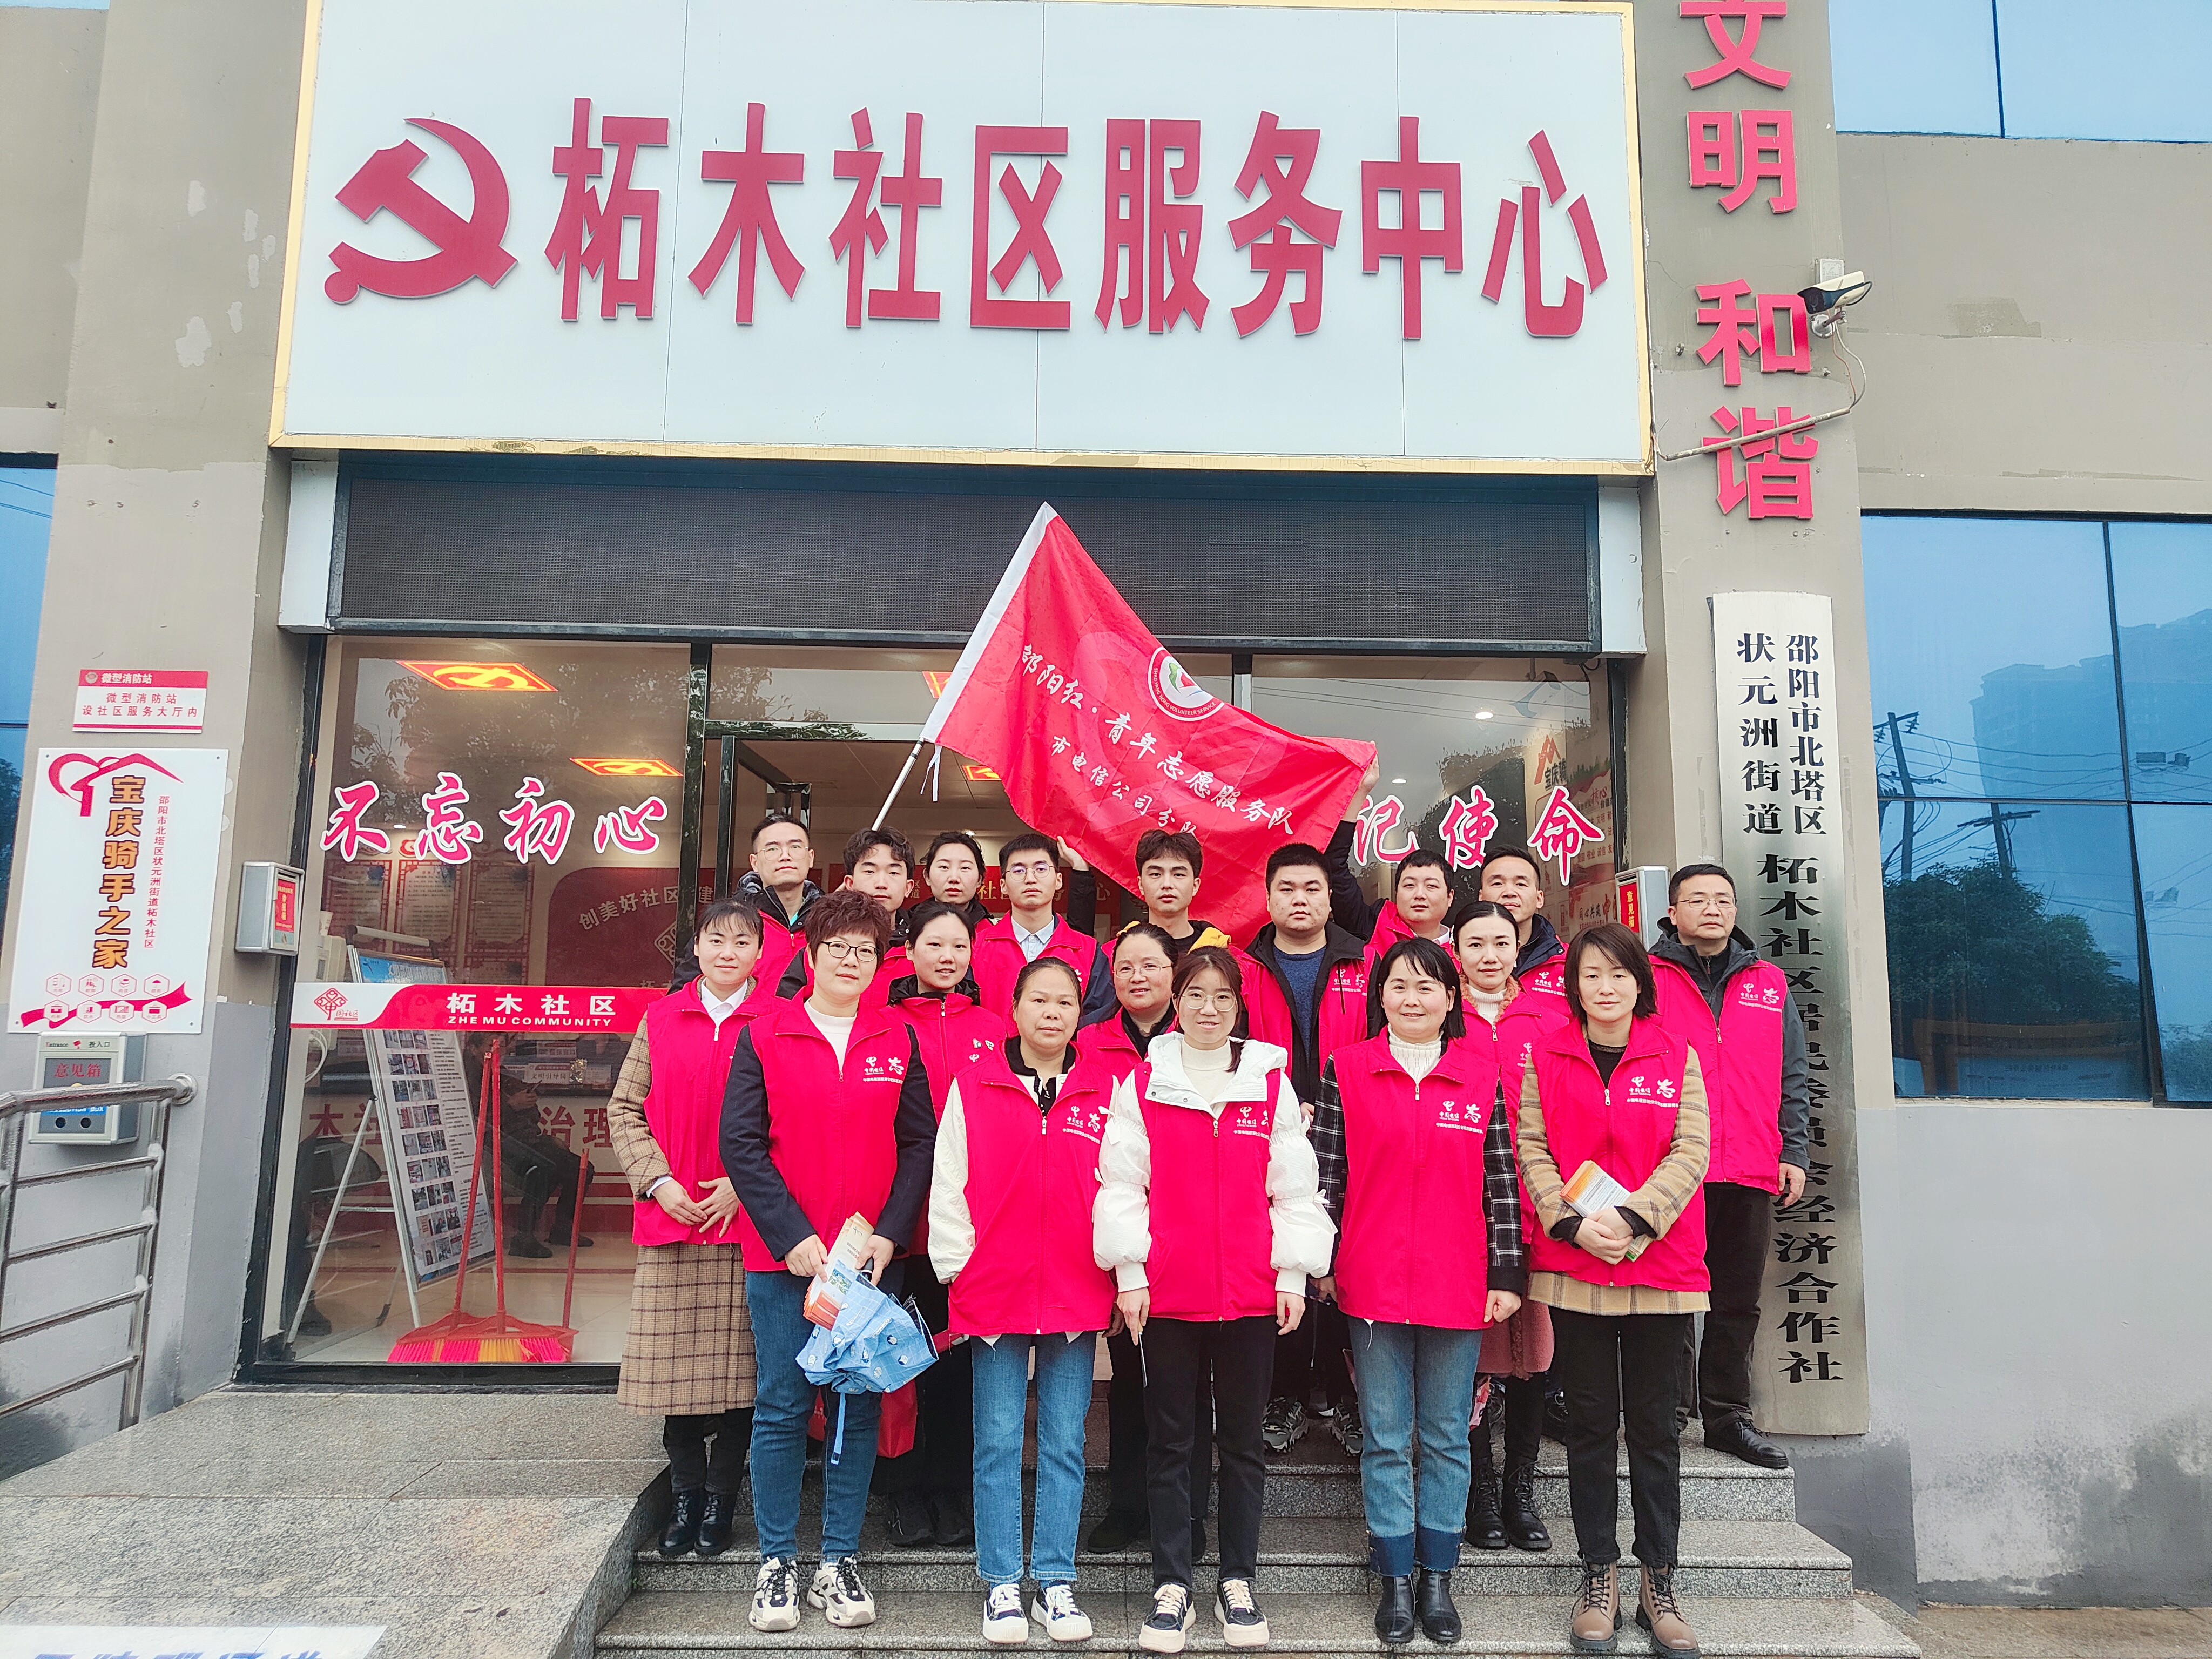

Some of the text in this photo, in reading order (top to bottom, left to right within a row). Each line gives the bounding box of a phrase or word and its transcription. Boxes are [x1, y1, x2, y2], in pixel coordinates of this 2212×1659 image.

[544, 96, 1609, 341] 柘木社区服务中心
[1679, 0, 1819, 520] 文明 和谐
[101, 673, 153, 684] 微型消防站
[106, 692, 178, 704] 微型消防站
[82, 705, 198, 718] 设社区服务大厅内
[1159, 694, 1170, 708] HONG
[1169, 705, 1197, 716] VOLUNTEER
[1197, 701, 1217, 714] SERVICE
[1736, 632, 1784, 835] 状元洲街道
[1785, 633, 1827, 837] 邵阳市北塔区
[320, 772, 667, 864] 不忘初心
[92, 775, 146, 970] 宝庆骑手之家
[144, 795, 170, 949] 邵阳市北塔区状元洲街道柘木社区
[579, 886, 679, 930] 创美好社区
[1626, 890, 1635, 928] 意见箱
[446, 992, 616, 1015] 柘木社区
[448, 1016, 611, 1026] ZHE MU COMMUNITY
[54, 1063, 102, 1078] 意见箱
